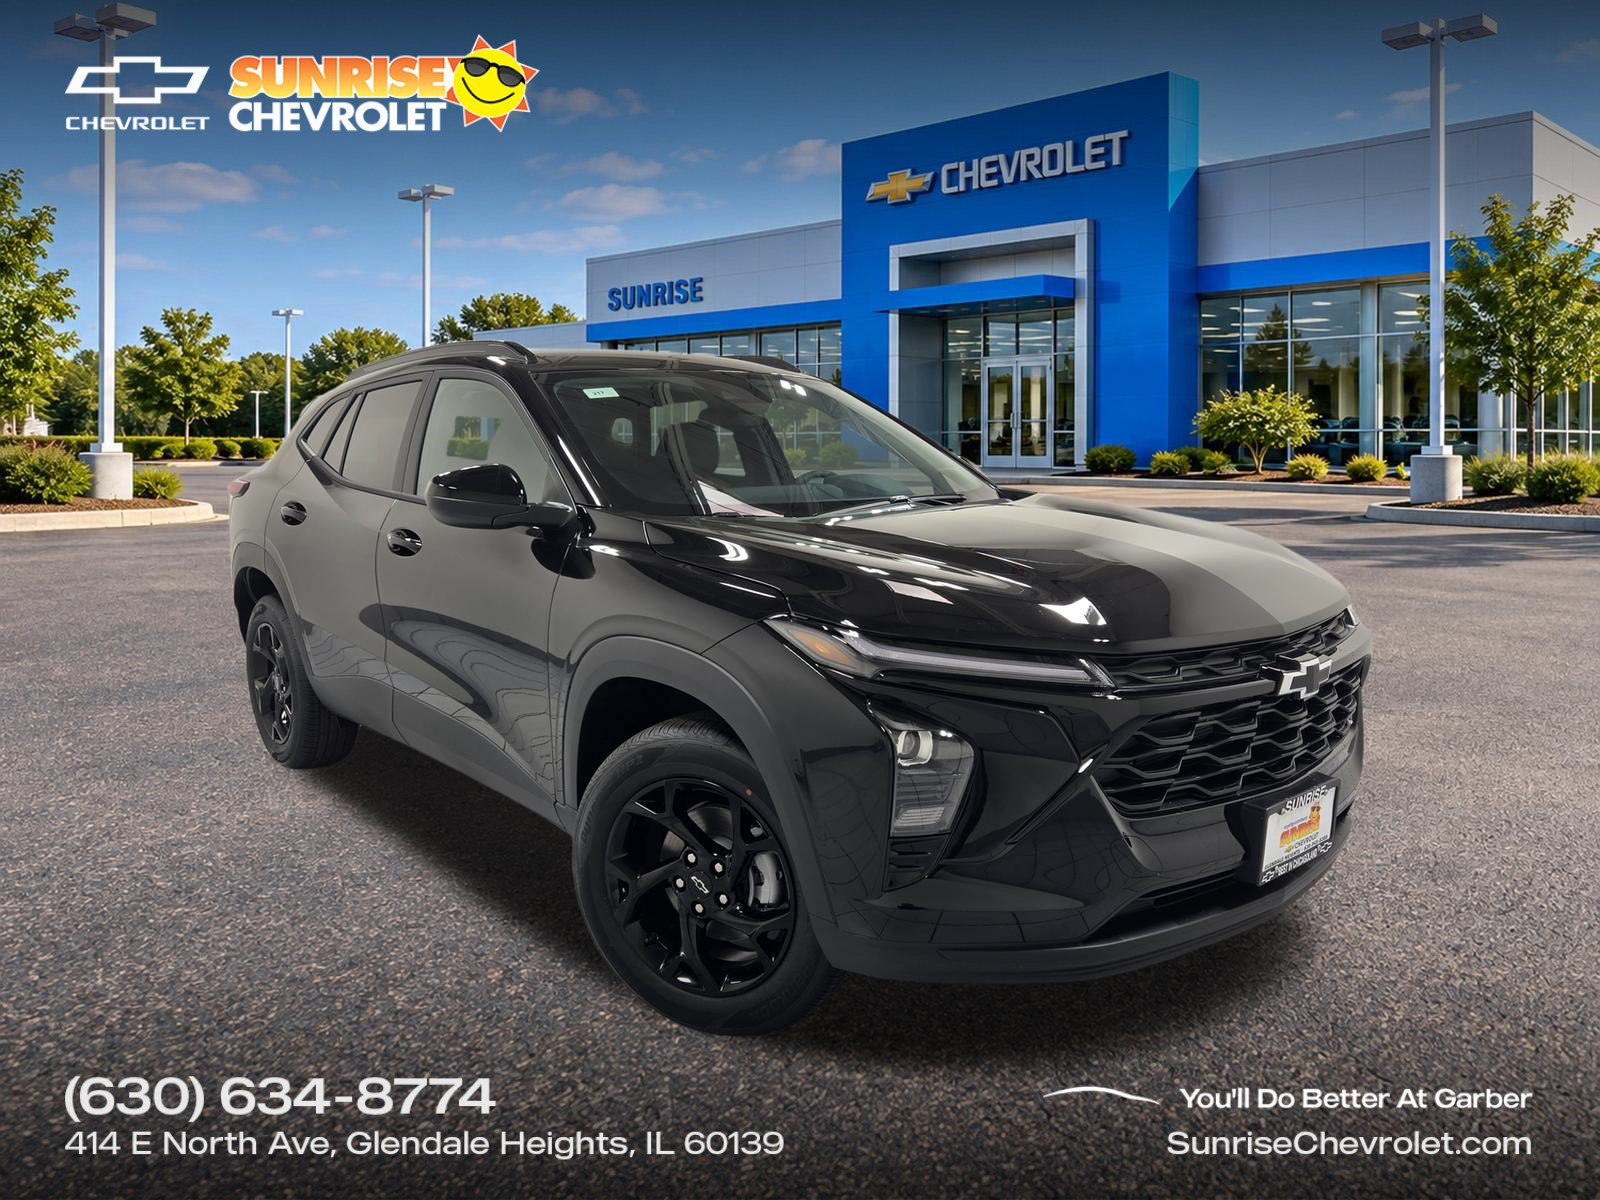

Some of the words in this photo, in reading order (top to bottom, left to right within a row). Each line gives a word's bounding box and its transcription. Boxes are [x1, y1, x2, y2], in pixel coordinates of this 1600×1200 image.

[941, 130, 1128, 194] CHEVROLET
[607, 277, 704, 312] SUNRISE
[1285, 785, 1327, 811] SUNRISE
